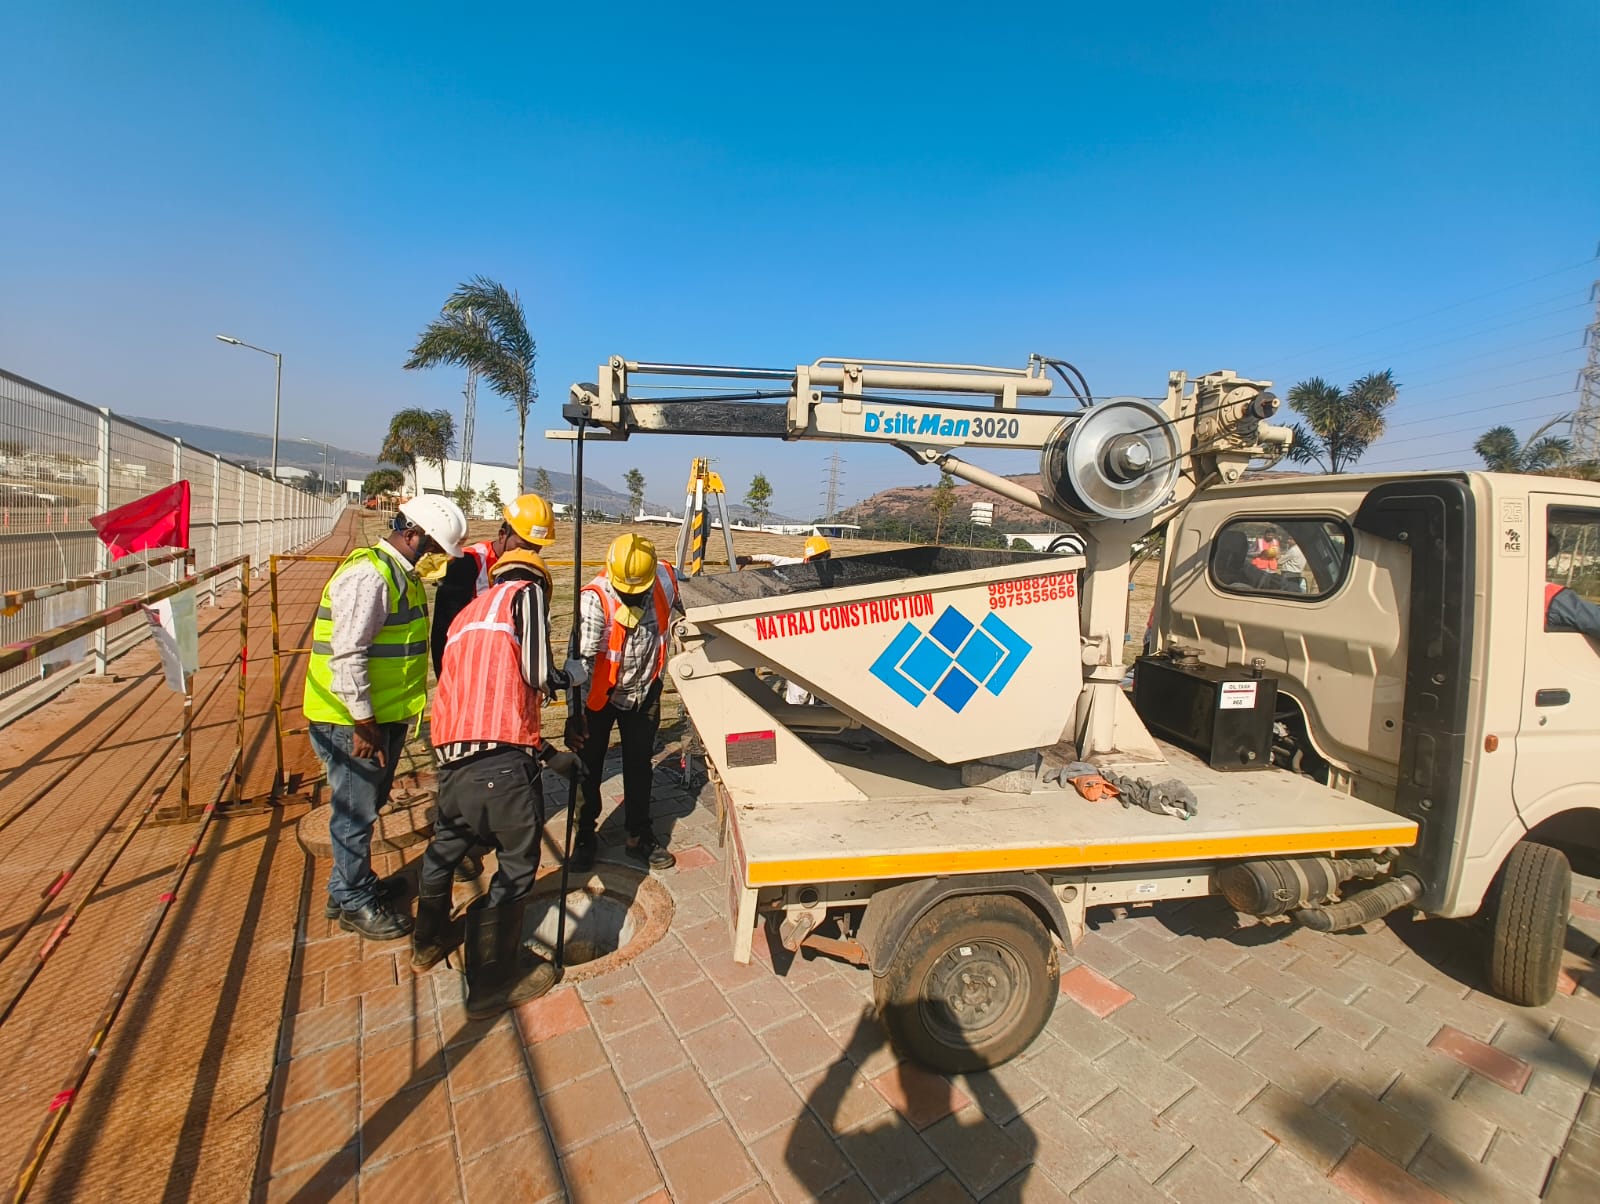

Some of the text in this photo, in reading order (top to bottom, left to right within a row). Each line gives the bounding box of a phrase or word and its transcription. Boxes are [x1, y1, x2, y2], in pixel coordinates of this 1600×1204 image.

[917, 413, 970, 437] Man
[972, 417, 1019, 439] 3020
[1504, 542, 1521, 551] ACE
[987, 572, 1075, 596] 9890882020
[989, 585, 1075, 610] 9975355656
[755, 592, 934, 641] NATRAJ CONSTRUCTION
